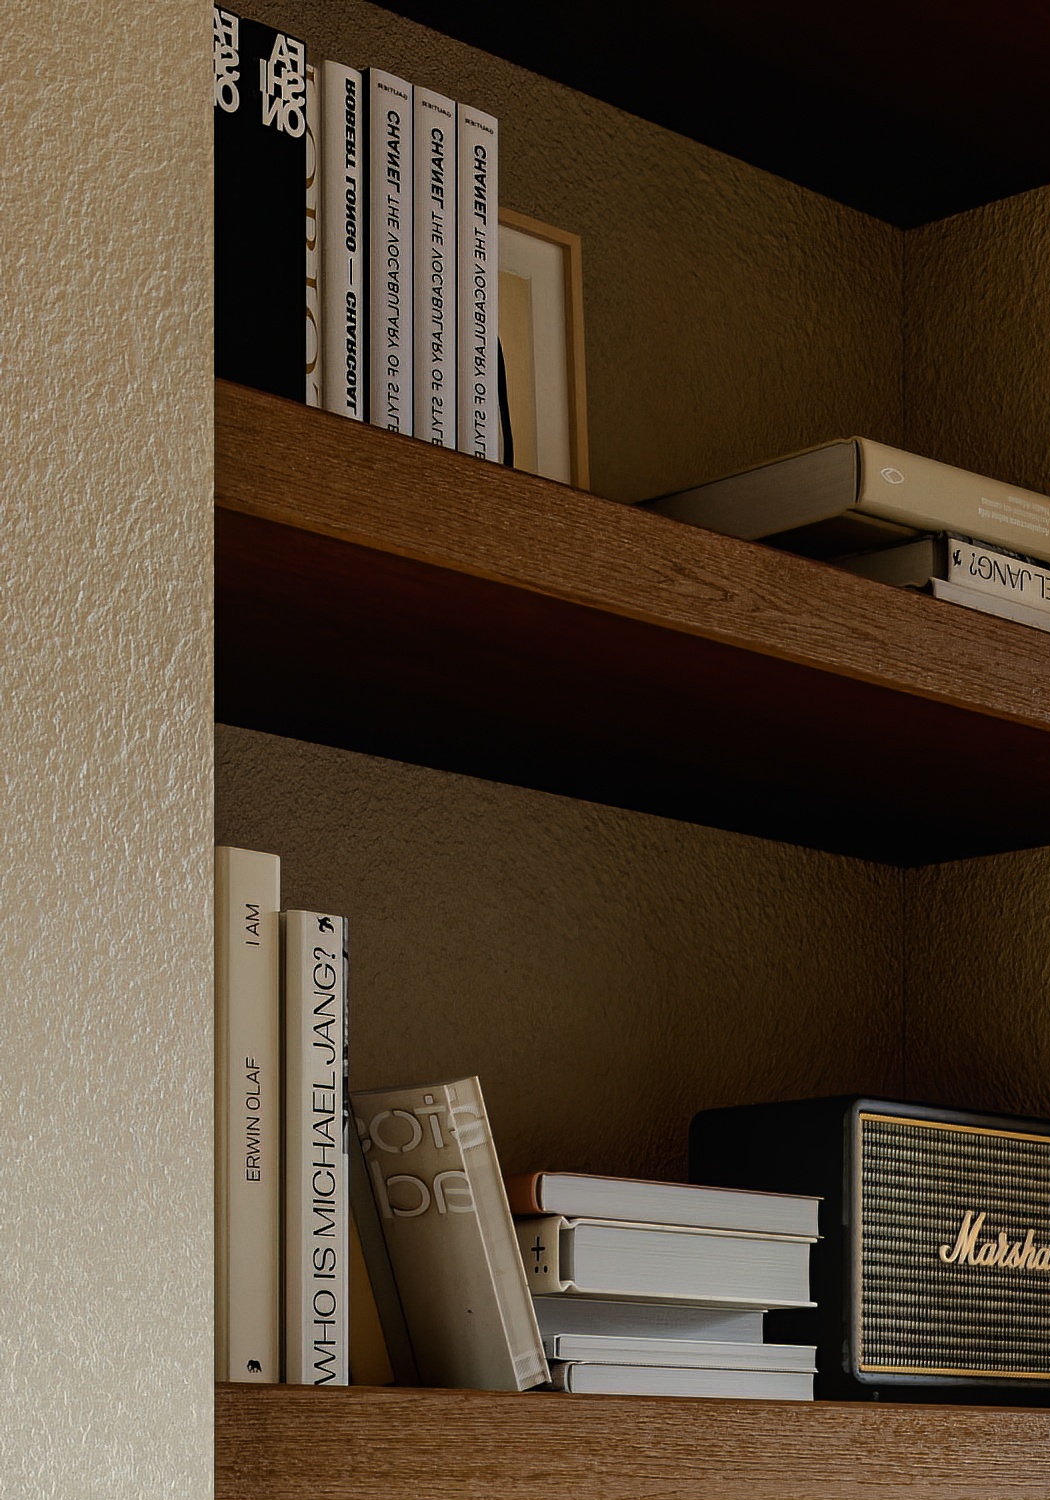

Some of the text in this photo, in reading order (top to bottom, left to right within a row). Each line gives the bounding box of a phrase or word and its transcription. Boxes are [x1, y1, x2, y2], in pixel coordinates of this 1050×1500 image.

[969, 552, 1032, 592] JANG?
[246, 903, 260, 937] AM
[246, 1056, 261, 1182] ERWIN OLAF
[313, 947, 337, 1386] WHO IS MICHAEL JANG?
